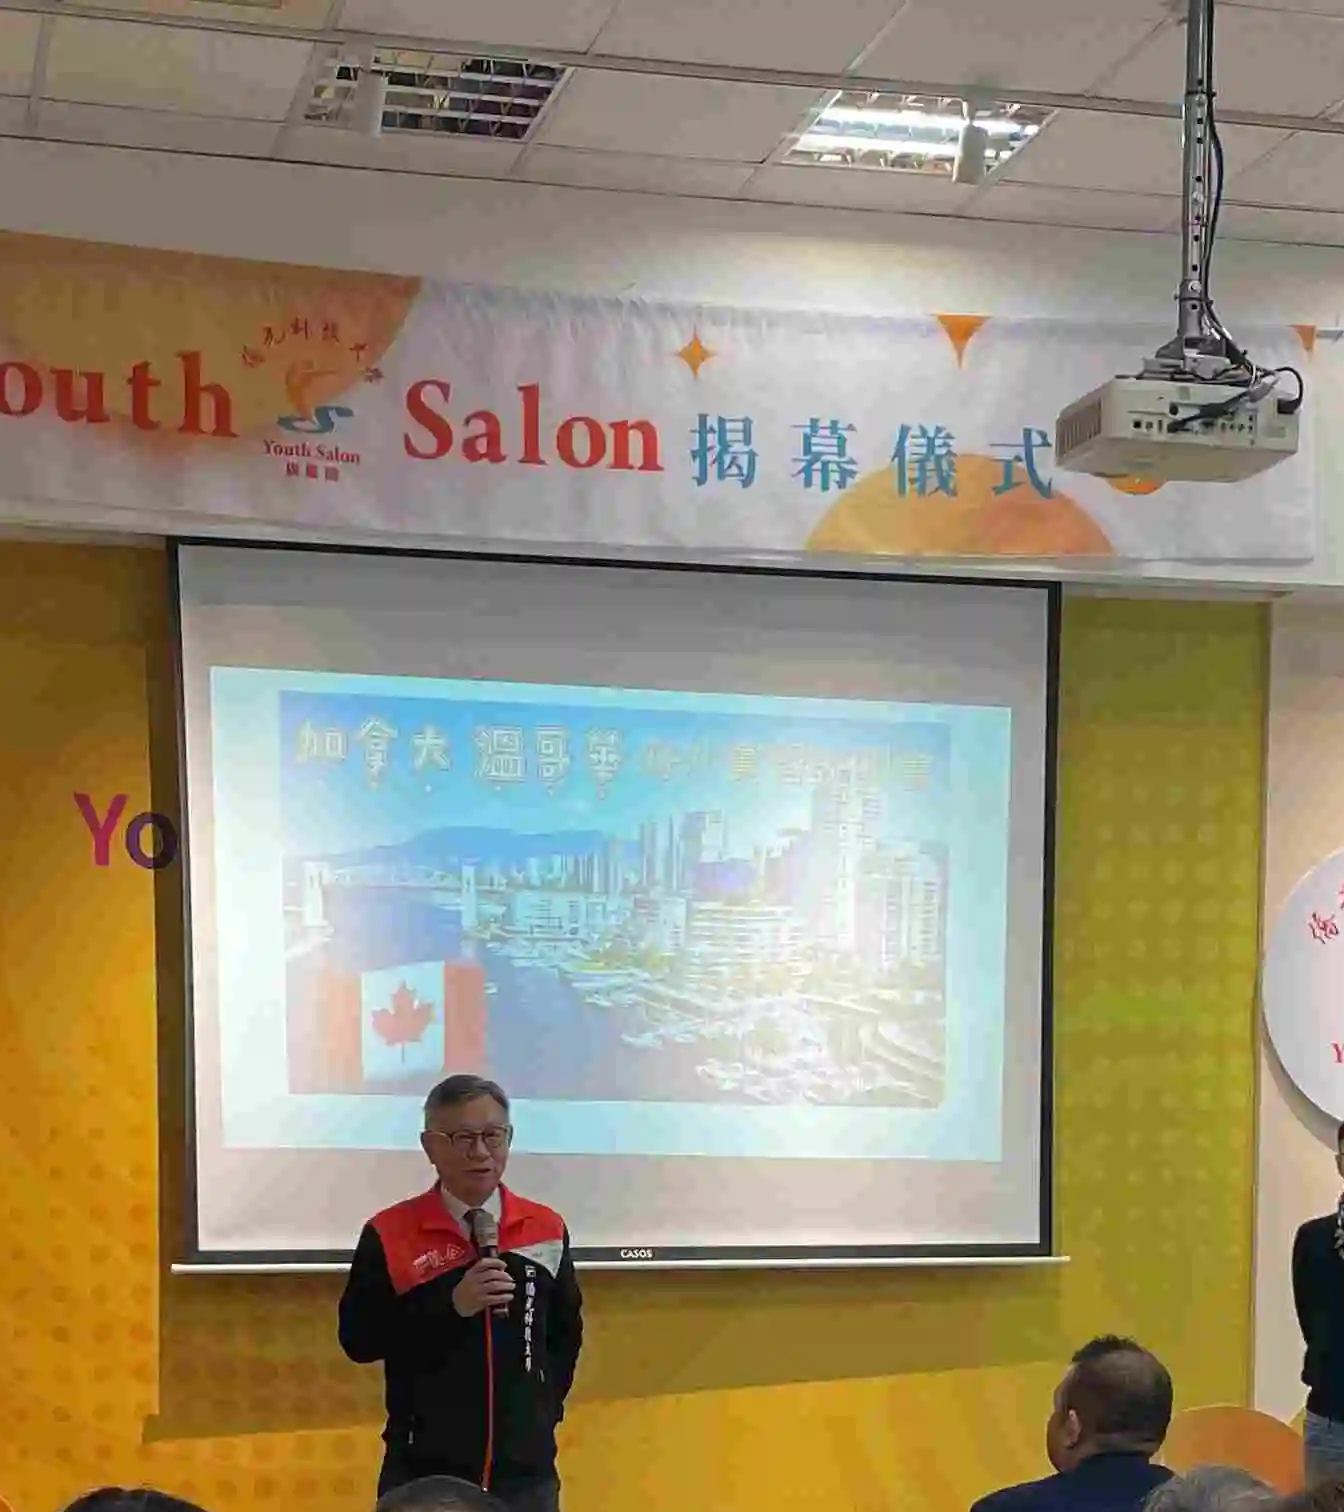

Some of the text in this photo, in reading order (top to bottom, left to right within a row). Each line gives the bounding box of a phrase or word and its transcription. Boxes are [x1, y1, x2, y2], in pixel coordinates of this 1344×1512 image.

[263, 439, 360, 464] Youth Salon
[404, 379, 664, 471] Salon
[690, 413, 1055, 500] 揭幕儀式
[73, 791, 178, 870] Yo
